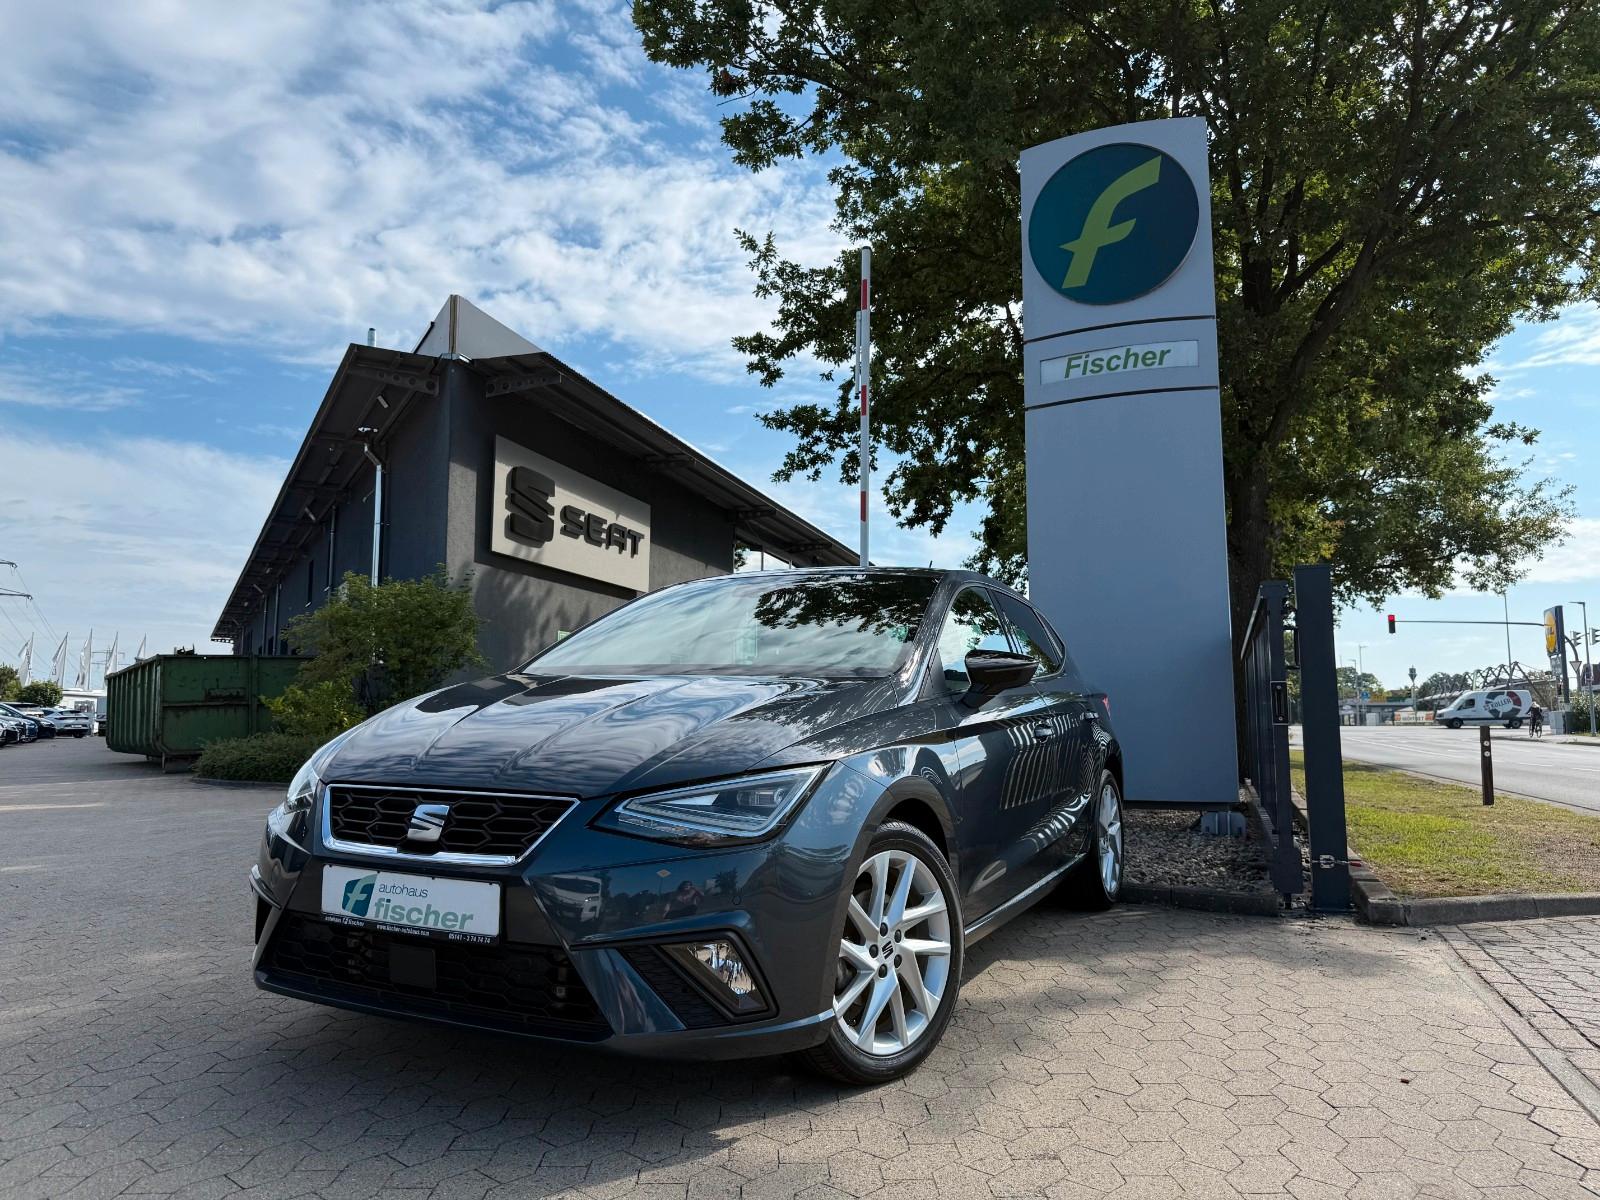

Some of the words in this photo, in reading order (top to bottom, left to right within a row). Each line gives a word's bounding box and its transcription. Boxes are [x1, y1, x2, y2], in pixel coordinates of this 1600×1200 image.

[1064, 347, 1171, 379] Fischer
[559, 504, 645, 559] SEAT
[378, 883, 429, 898] autohaus
[374, 897, 474, 930] fischer
